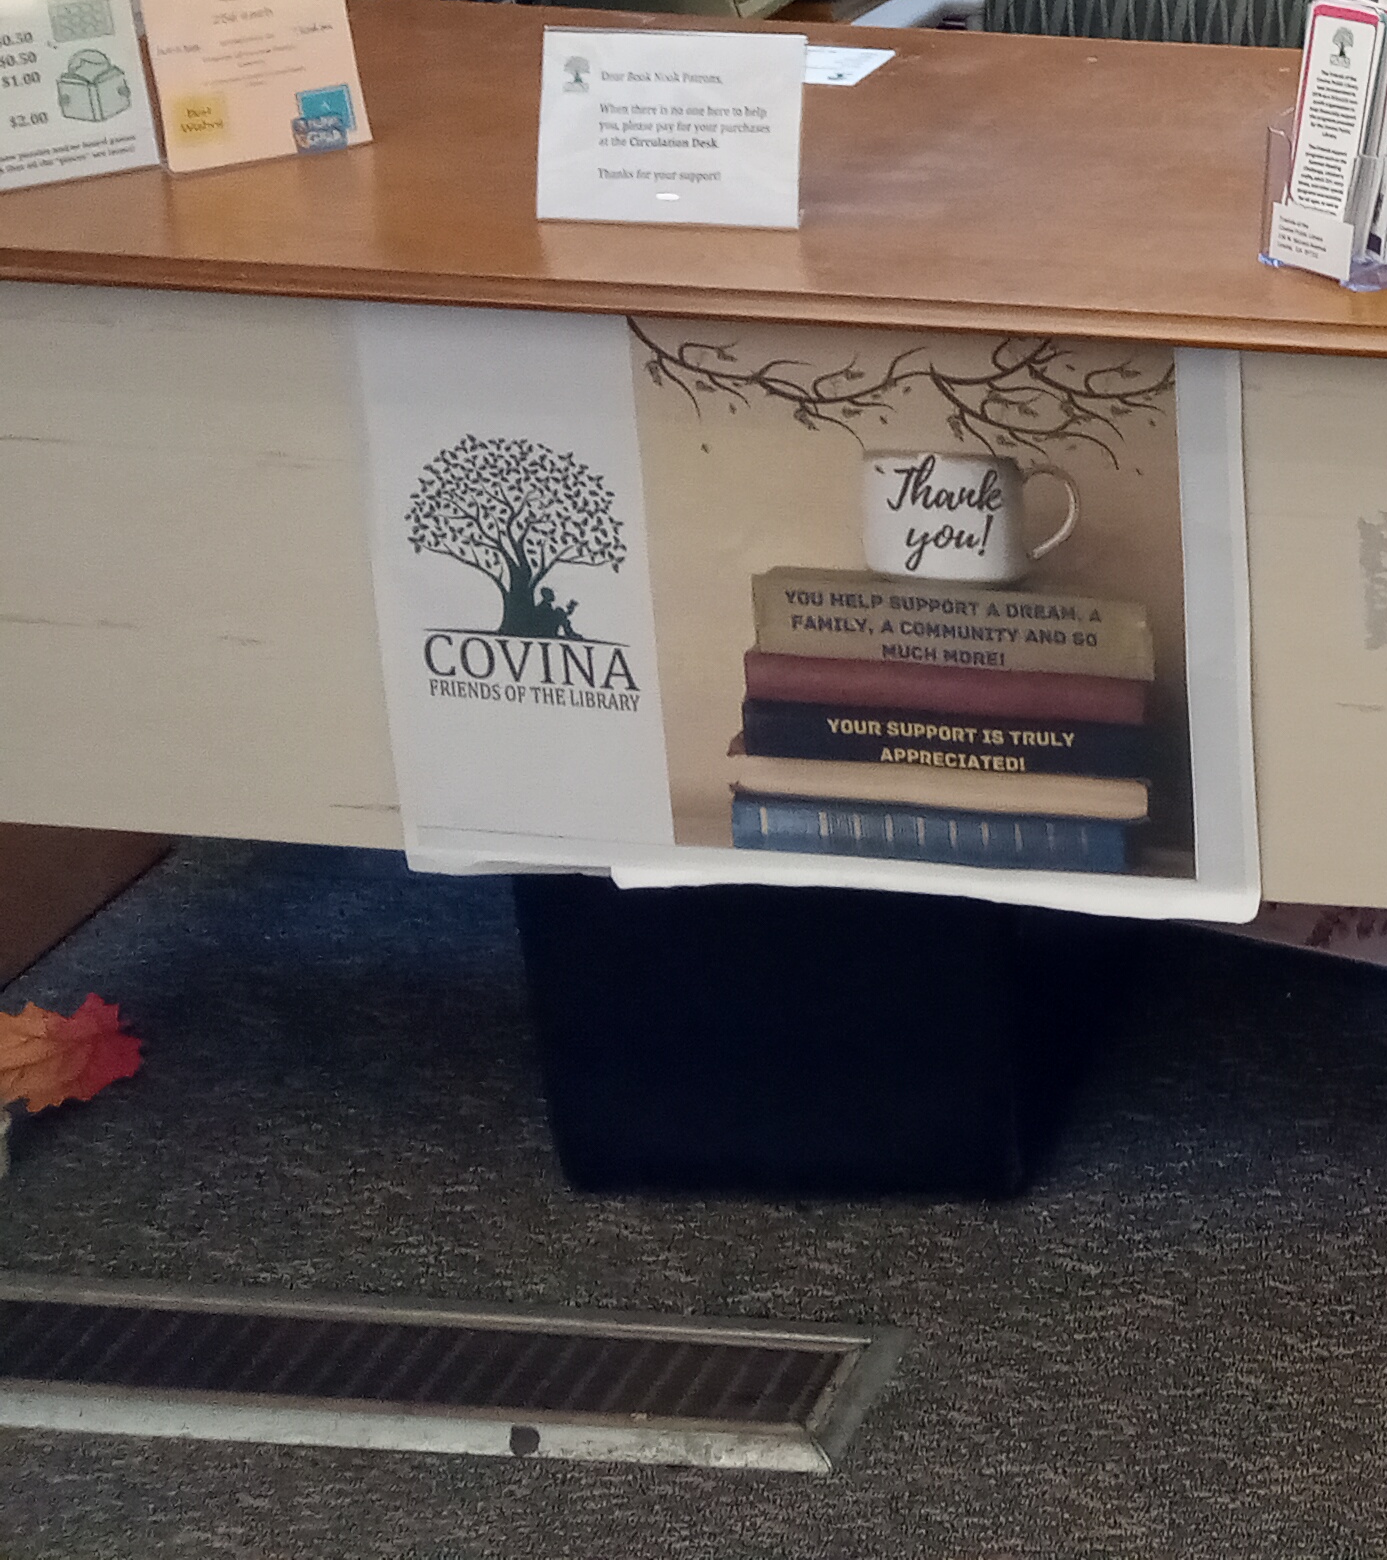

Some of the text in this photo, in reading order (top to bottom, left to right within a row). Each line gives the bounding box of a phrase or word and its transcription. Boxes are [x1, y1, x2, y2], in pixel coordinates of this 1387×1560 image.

[9, 110, 49, 128] $2.00
[887, 454, 1004, 512] Thank
[905, 514, 995, 571] you!
[785, 589, 823, 607] YOU
[830, 591, 883, 609] HELP
[890, 594, 980, 616] SUPPORT
[987, 602, 1001, 618] A
[1089, 608, 1102, 623] A
[791, 614, 1098, 648] FAMILY, A COMMUNITY AND SO
[424, 633, 640, 692] COVINA
[882, 643, 1006, 667] MUCH MORE!
[429, 678, 641, 713] FRIENDS OF THE LIBRARY
[827, 717, 1076, 749] YOUR SUPPORT IS TRULY
[880, 746, 1026, 773] APPRECIATED!
